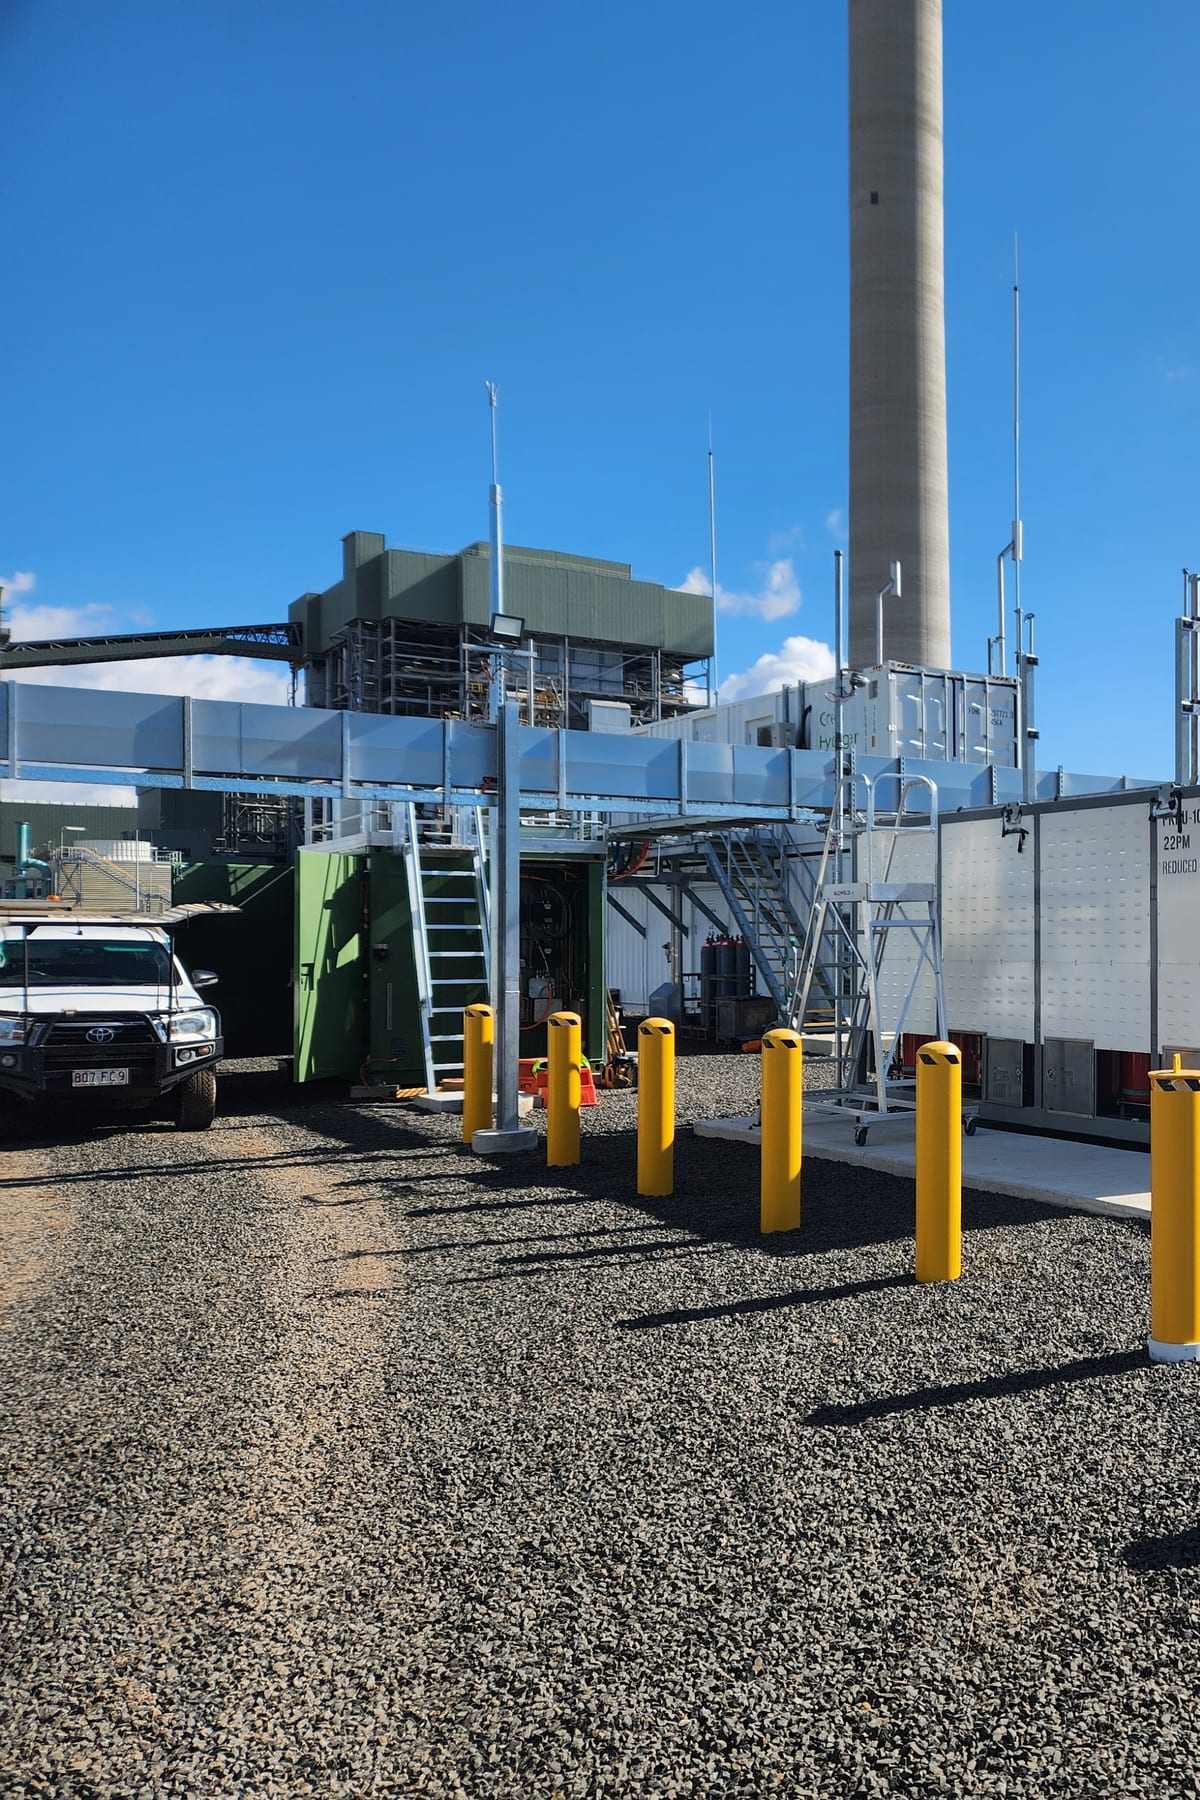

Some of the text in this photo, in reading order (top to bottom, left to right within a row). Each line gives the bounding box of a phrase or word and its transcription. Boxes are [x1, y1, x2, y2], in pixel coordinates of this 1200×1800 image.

[1163, 835, 1190, 850] 22PM
[1162, 859, 1197, 875] REDUCED
[74, 1072, 96, 1083] 807
